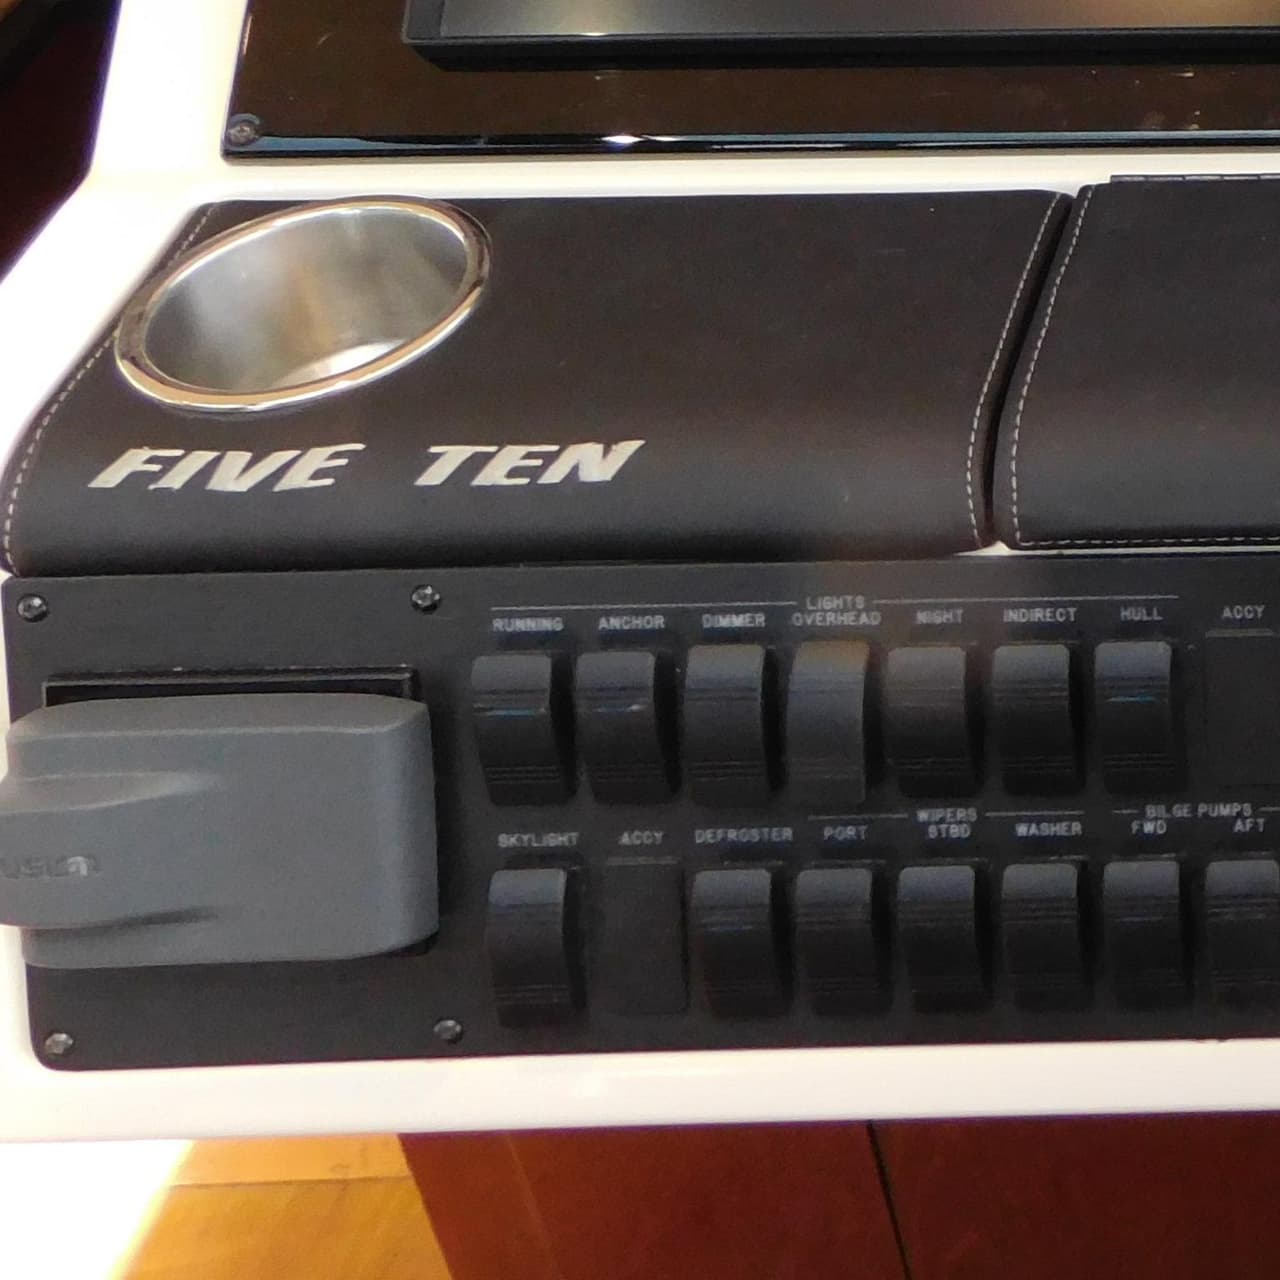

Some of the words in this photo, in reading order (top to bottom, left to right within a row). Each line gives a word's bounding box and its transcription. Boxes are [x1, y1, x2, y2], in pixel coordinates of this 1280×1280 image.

[88, 442, 366, 492] FIVE
[414, 439, 646, 487] TEN
[806, 595, 866, 610] LIGHTS
[792, 611, 882, 627] OVERHEAD
[915, 608, 964, 625] NIGHT
[1003, 606, 1077, 624] INDIRECT
[1120, 605, 1164, 622] HULL
[1221, 604, 1265, 620] ACCY
[493, 617, 565, 633] RUNNING
[598, 615, 666, 631] ANCHOR
[702, 613, 766, 629] DIMMER
[916, 806, 977, 824] WIPERS
[1145, 802, 1192, 819] BILGE
[1197, 801, 1252, 819] PUMPS
[824, 825, 869, 841] PORT
[928, 823, 972, 839] STBD
[1015, 821, 1082, 838] WASHER
[1131, 820, 1168, 836] FWD
[1233, 818, 1266, 834] AFT
[498, 832, 580, 848] SKYLIGHT
[618, 830, 664, 846] ACCY
[695, 826, 793, 844] DEFROSTER
